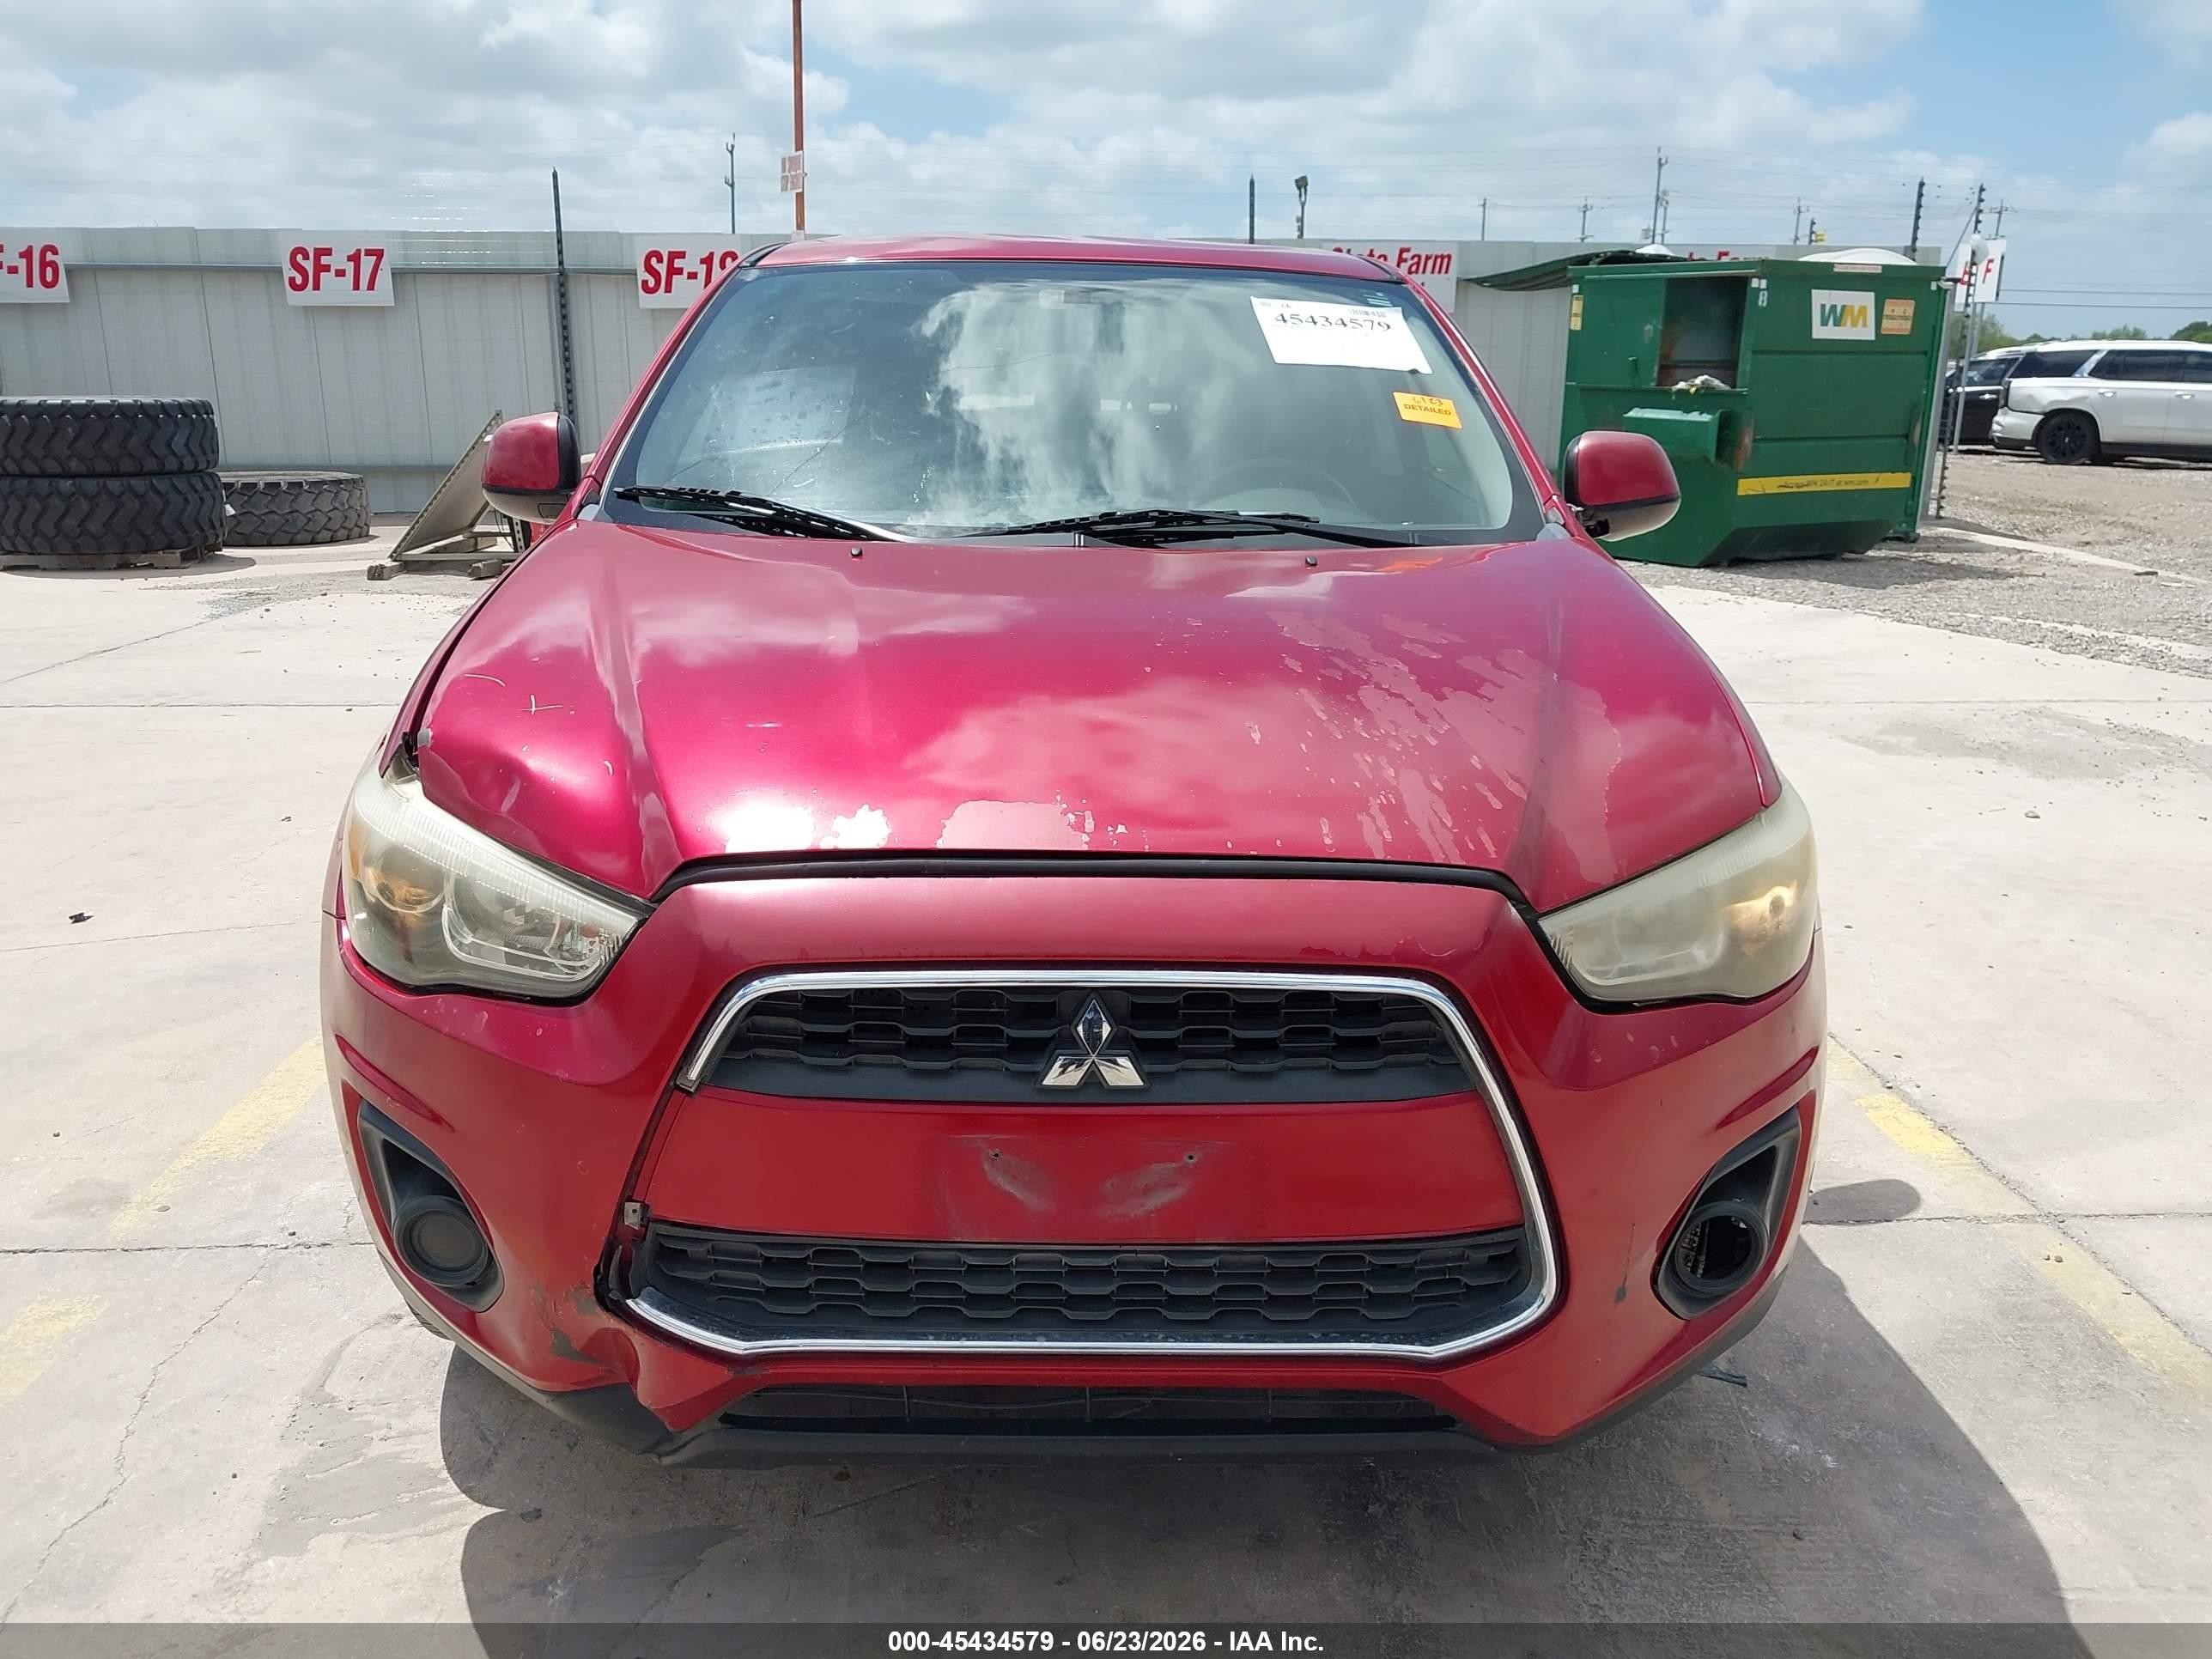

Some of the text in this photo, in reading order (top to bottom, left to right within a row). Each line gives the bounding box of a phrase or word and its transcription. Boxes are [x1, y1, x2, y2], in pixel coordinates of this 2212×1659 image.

[0, 244, 60, 289] -16
[288, 246, 385, 292] SF-17
[1396, 246, 1453, 276] Farm
[1274, 313, 1391, 331] 45434579
[1820, 303, 1868, 328] WM
[1403, 404, 1452, 416] DETAILED
